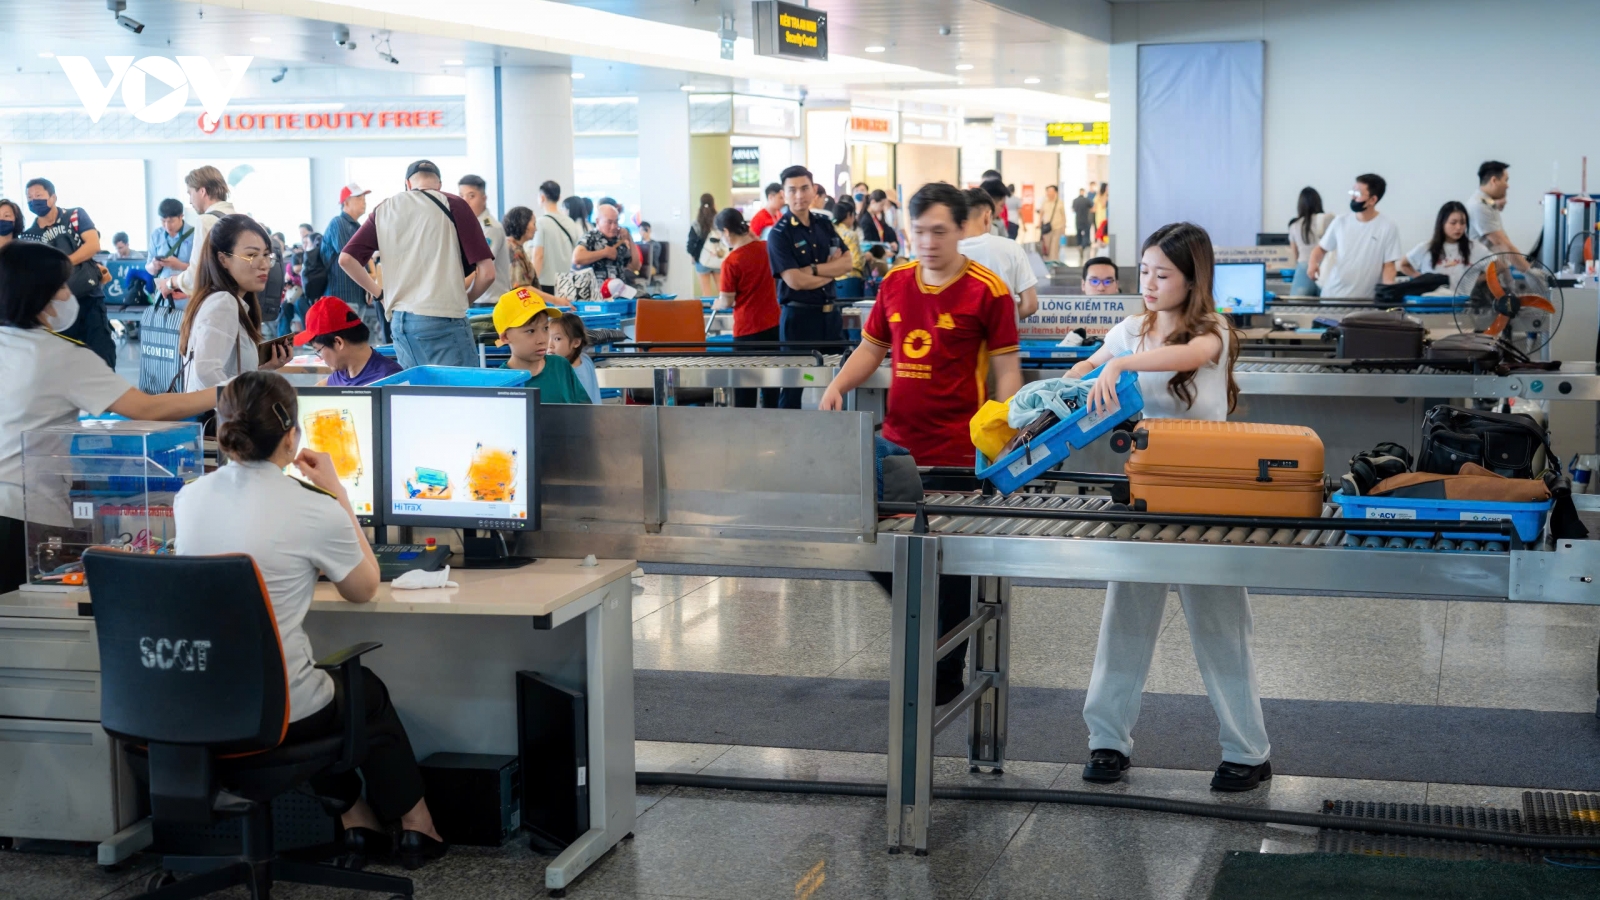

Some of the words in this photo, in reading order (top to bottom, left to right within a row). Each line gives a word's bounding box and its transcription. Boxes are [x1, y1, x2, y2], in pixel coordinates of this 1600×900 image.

[785, 30, 803, 48] Security
[802, 33, 818, 48] Control
[223, 112, 301, 131] LOTTE
[304, 111, 374, 130] DUTY
[377, 109, 443, 129] FREE
[1042, 299, 1072, 311] LÒNG
[1074, 298, 1101, 311] KIỂM
[1103, 301, 1125, 311] TRA
[1100, 315, 1113, 324] TRA
[1031, 325, 1054, 335] items
[77, 506, 89, 517] 11
